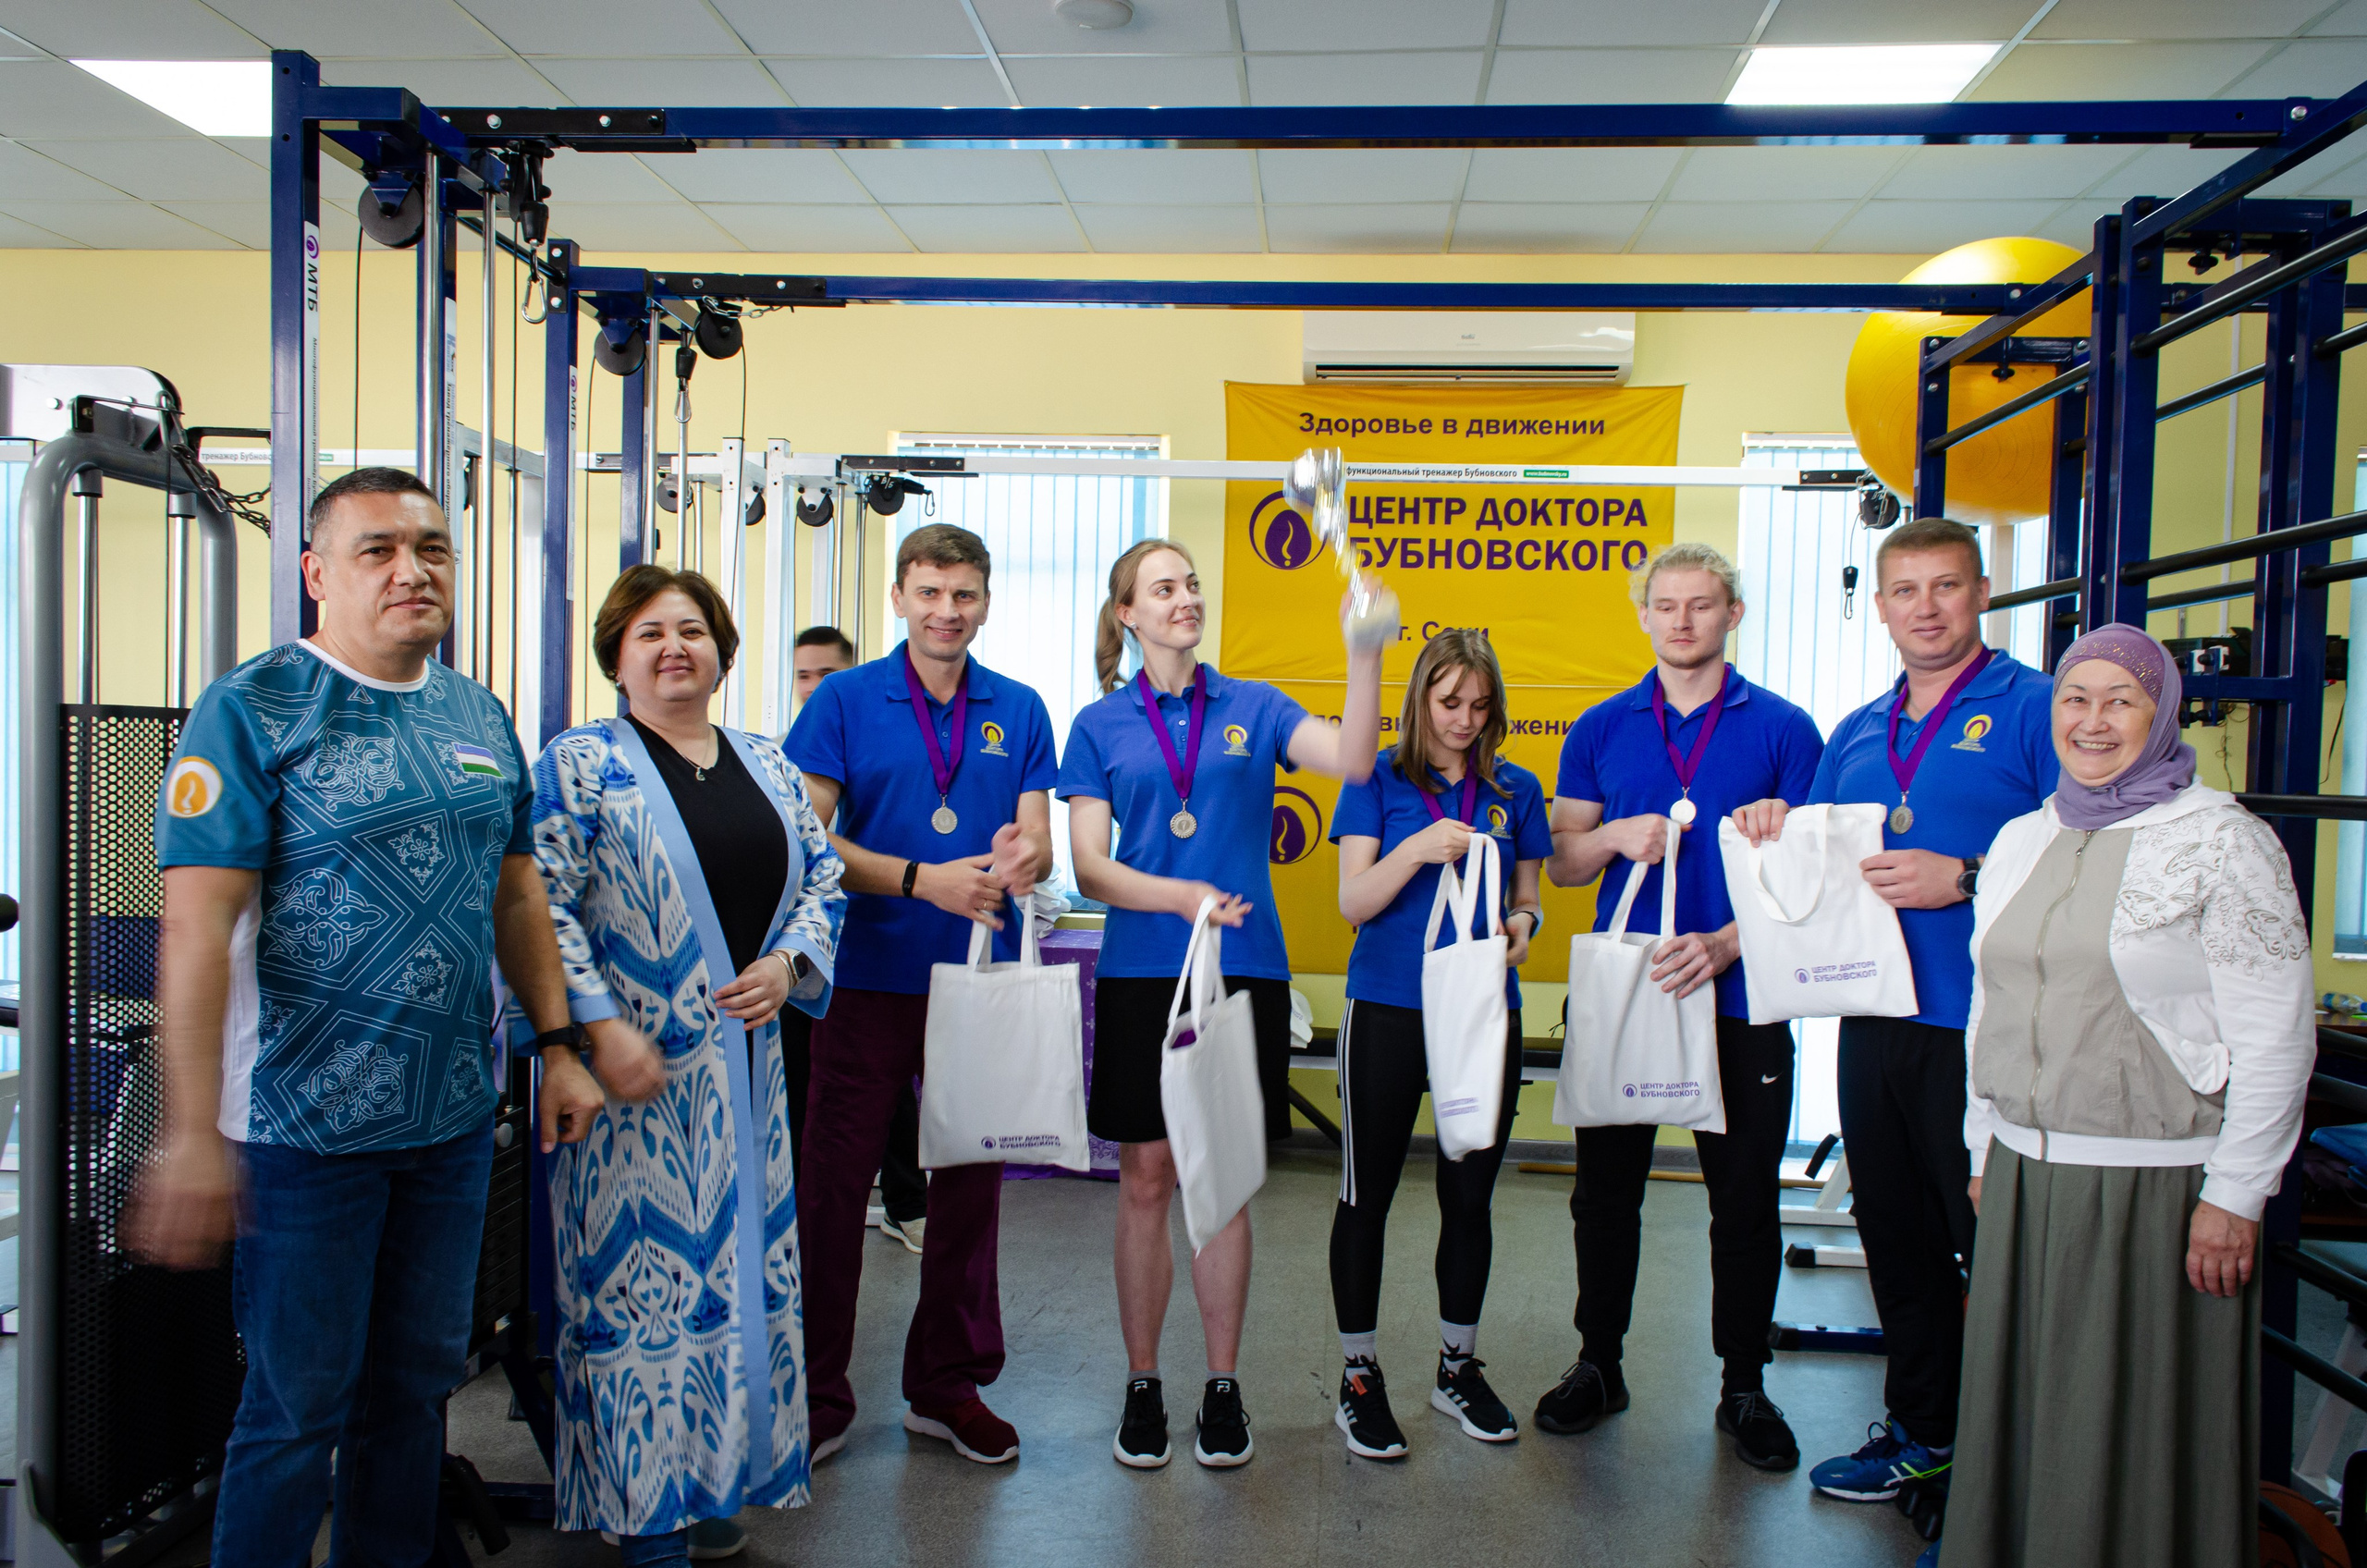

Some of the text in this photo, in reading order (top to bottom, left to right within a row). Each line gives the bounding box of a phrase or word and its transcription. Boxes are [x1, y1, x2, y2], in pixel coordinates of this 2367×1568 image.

[307, 263, 318, 312] МТБ
[1299, 412, 1605, 437] Здоровье в движении
[240, 452, 272, 461] Бубновс
[1346, 466, 1517, 478] функциональный тренажер Бубновского
[1350, 496, 1649, 531] ЦЕНТР ДОКТОРА
[1351, 537, 1649, 571] БУБНОВСКОГО
[1811, 961, 1876, 974] ЦЕНТР ДОКТОРА
[1813, 969, 1878, 983] БУБНОВСКОГО
[1665, 1081, 1699, 1090] ДОКТОРА
[1640, 1089, 1700, 1098] БУБНОВСКОГО
